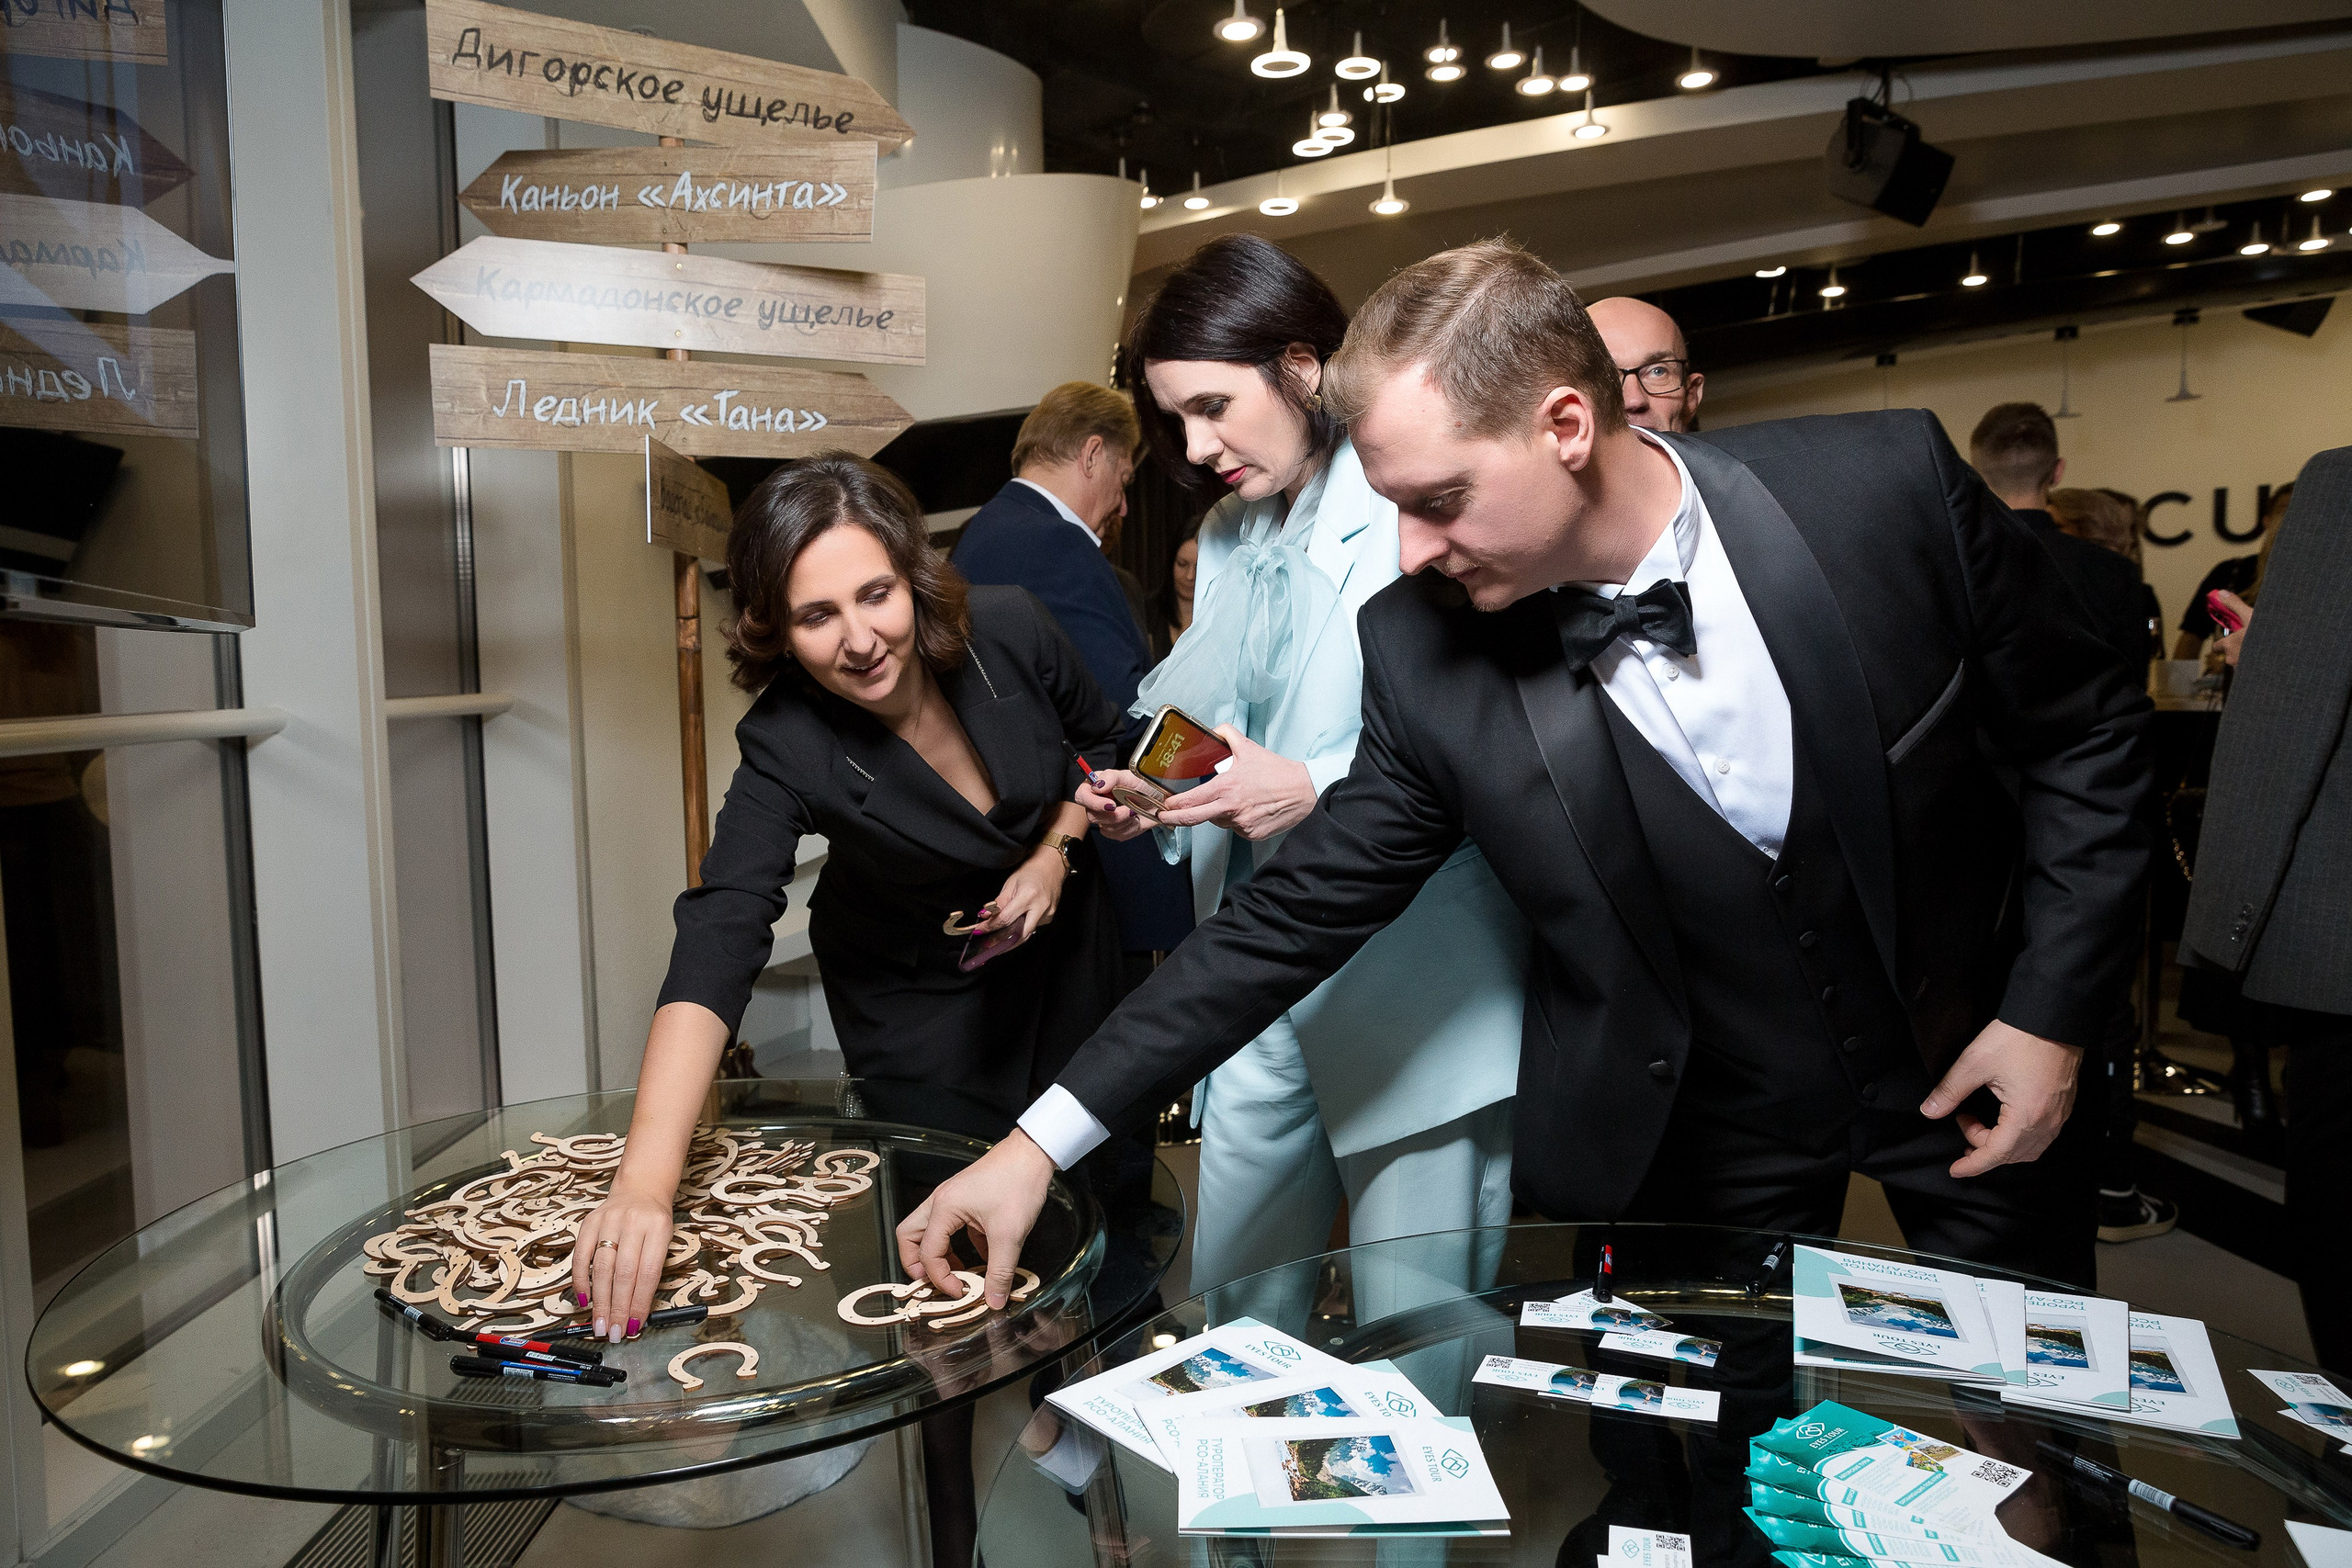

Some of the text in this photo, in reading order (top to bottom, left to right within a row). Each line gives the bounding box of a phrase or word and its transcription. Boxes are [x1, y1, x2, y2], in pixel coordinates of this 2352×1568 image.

[452, 28, 854, 134] Дигорское ущелье
[500, 171, 848, 214] Каньон «Ахсинта»
[475, 265, 895, 331] Кармадонское ущелье
[492, 379, 828, 432] Ледник «Тана»
[2143, 484, 2272, 547] CU
[1159, 733, 1185, 768] 18:41
[1840, 1262, 1940, 1283] ТУРОПЕРАТОР
[1842, 1258, 1937, 1278] РСО-АЛАНИЯ
[2025, 1295, 2084, 1306] РСО-АЛ
[2027, 1300, 2086, 1311] ТУРОПЕ
[1245, 1344, 1292, 1370] EYES TOUR
[1872, 1332, 1940, 1349] EYES TOUR
[1093, 1394, 1146, 1432] ТУРОПЕРА
[1364, 1391, 1384, 1407] EYES
[1082, 1401, 1154, 1445] РСО-АЛАНИЯ
[1809, 1427, 1845, 1449] EYES TOUR
[1197, 1438, 1209, 1499] РСО-АЛАНИЯ
[1211, 1438, 1225, 1501] ТУРОПЕРАТОР
[1422, 1446, 1442, 1483] EYES TOUR
[1643, 1537, 1651, 1566] EYES TOUR
